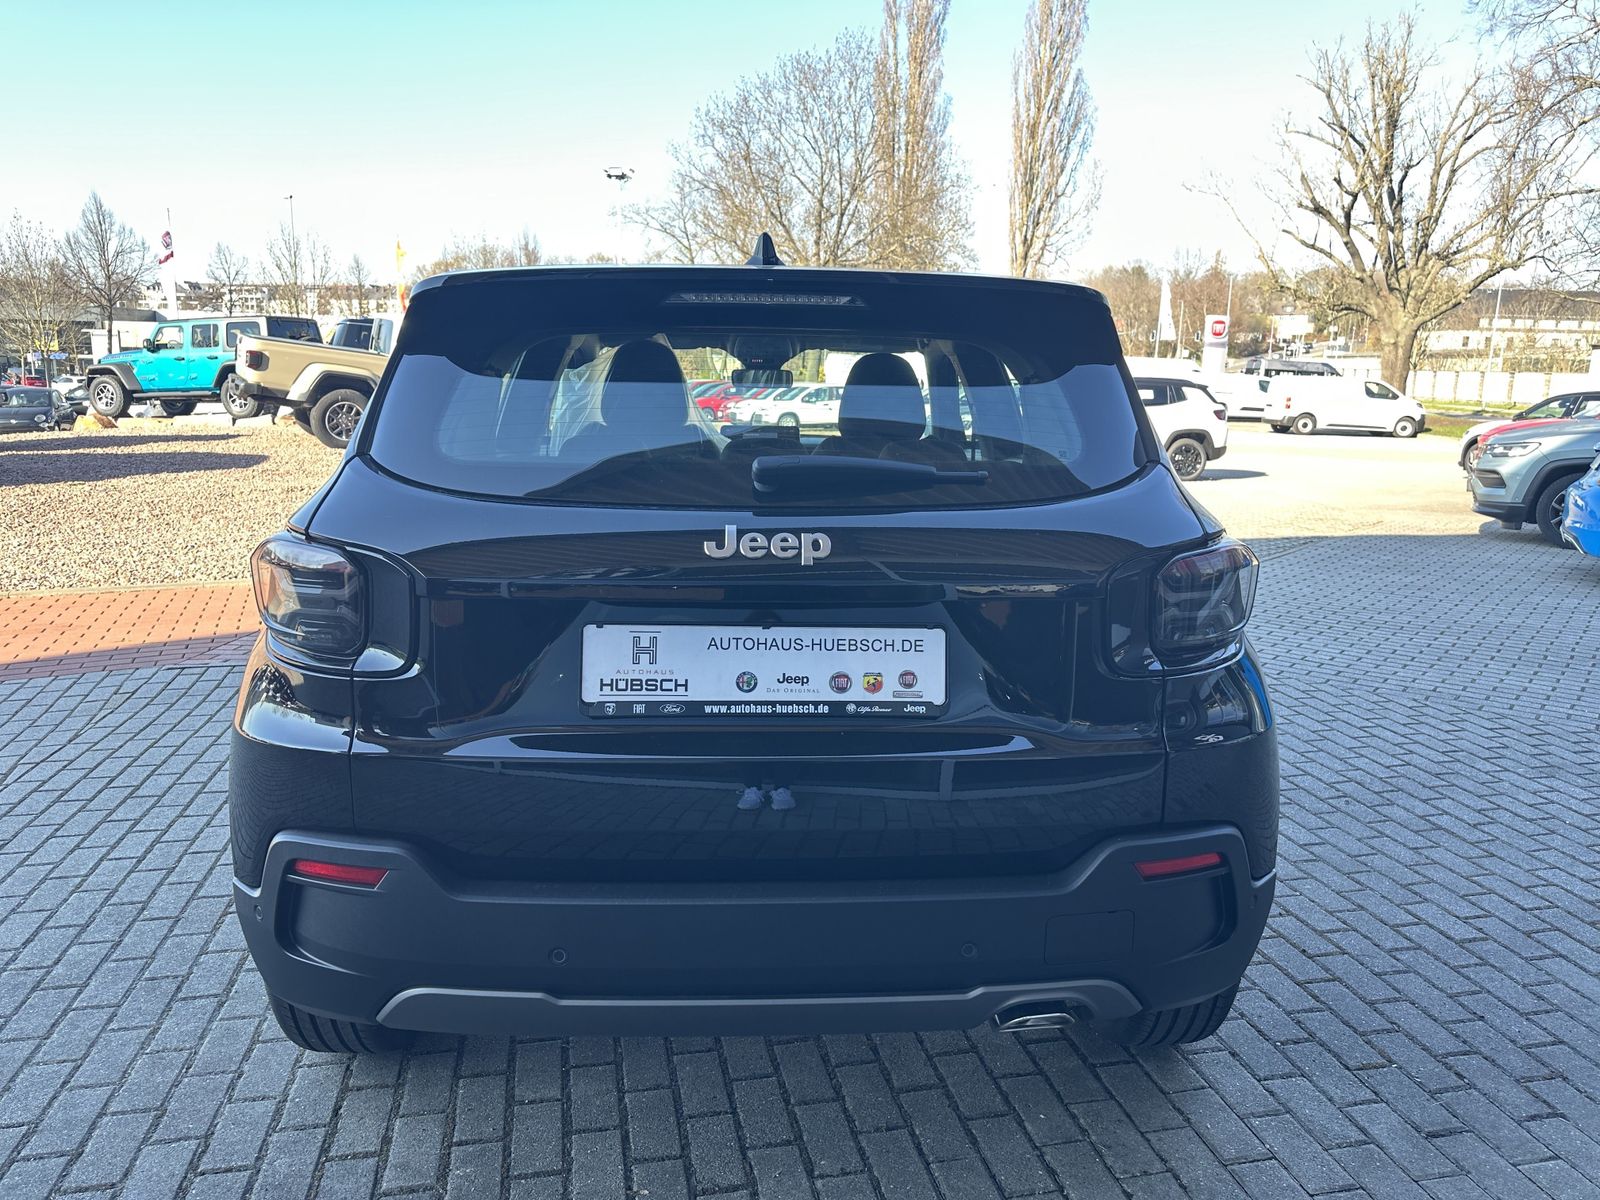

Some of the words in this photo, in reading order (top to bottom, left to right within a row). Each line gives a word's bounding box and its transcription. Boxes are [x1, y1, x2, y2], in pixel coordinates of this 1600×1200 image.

[704, 524, 832, 566] Jeep
[707, 636, 925, 653] AUTOHAUS-HUEBSCH.DE
[776, 672, 810, 686] Jeep
[834, 677, 849, 688] FIAT
[599, 678, 689, 692] HÜBSCH
[633, 704, 646, 714] FIAT
[664, 705, 681, 713] Ford
[704, 703, 829, 714] www.autohaus-huebsch.de
[903, 704, 926, 714] Jeep
